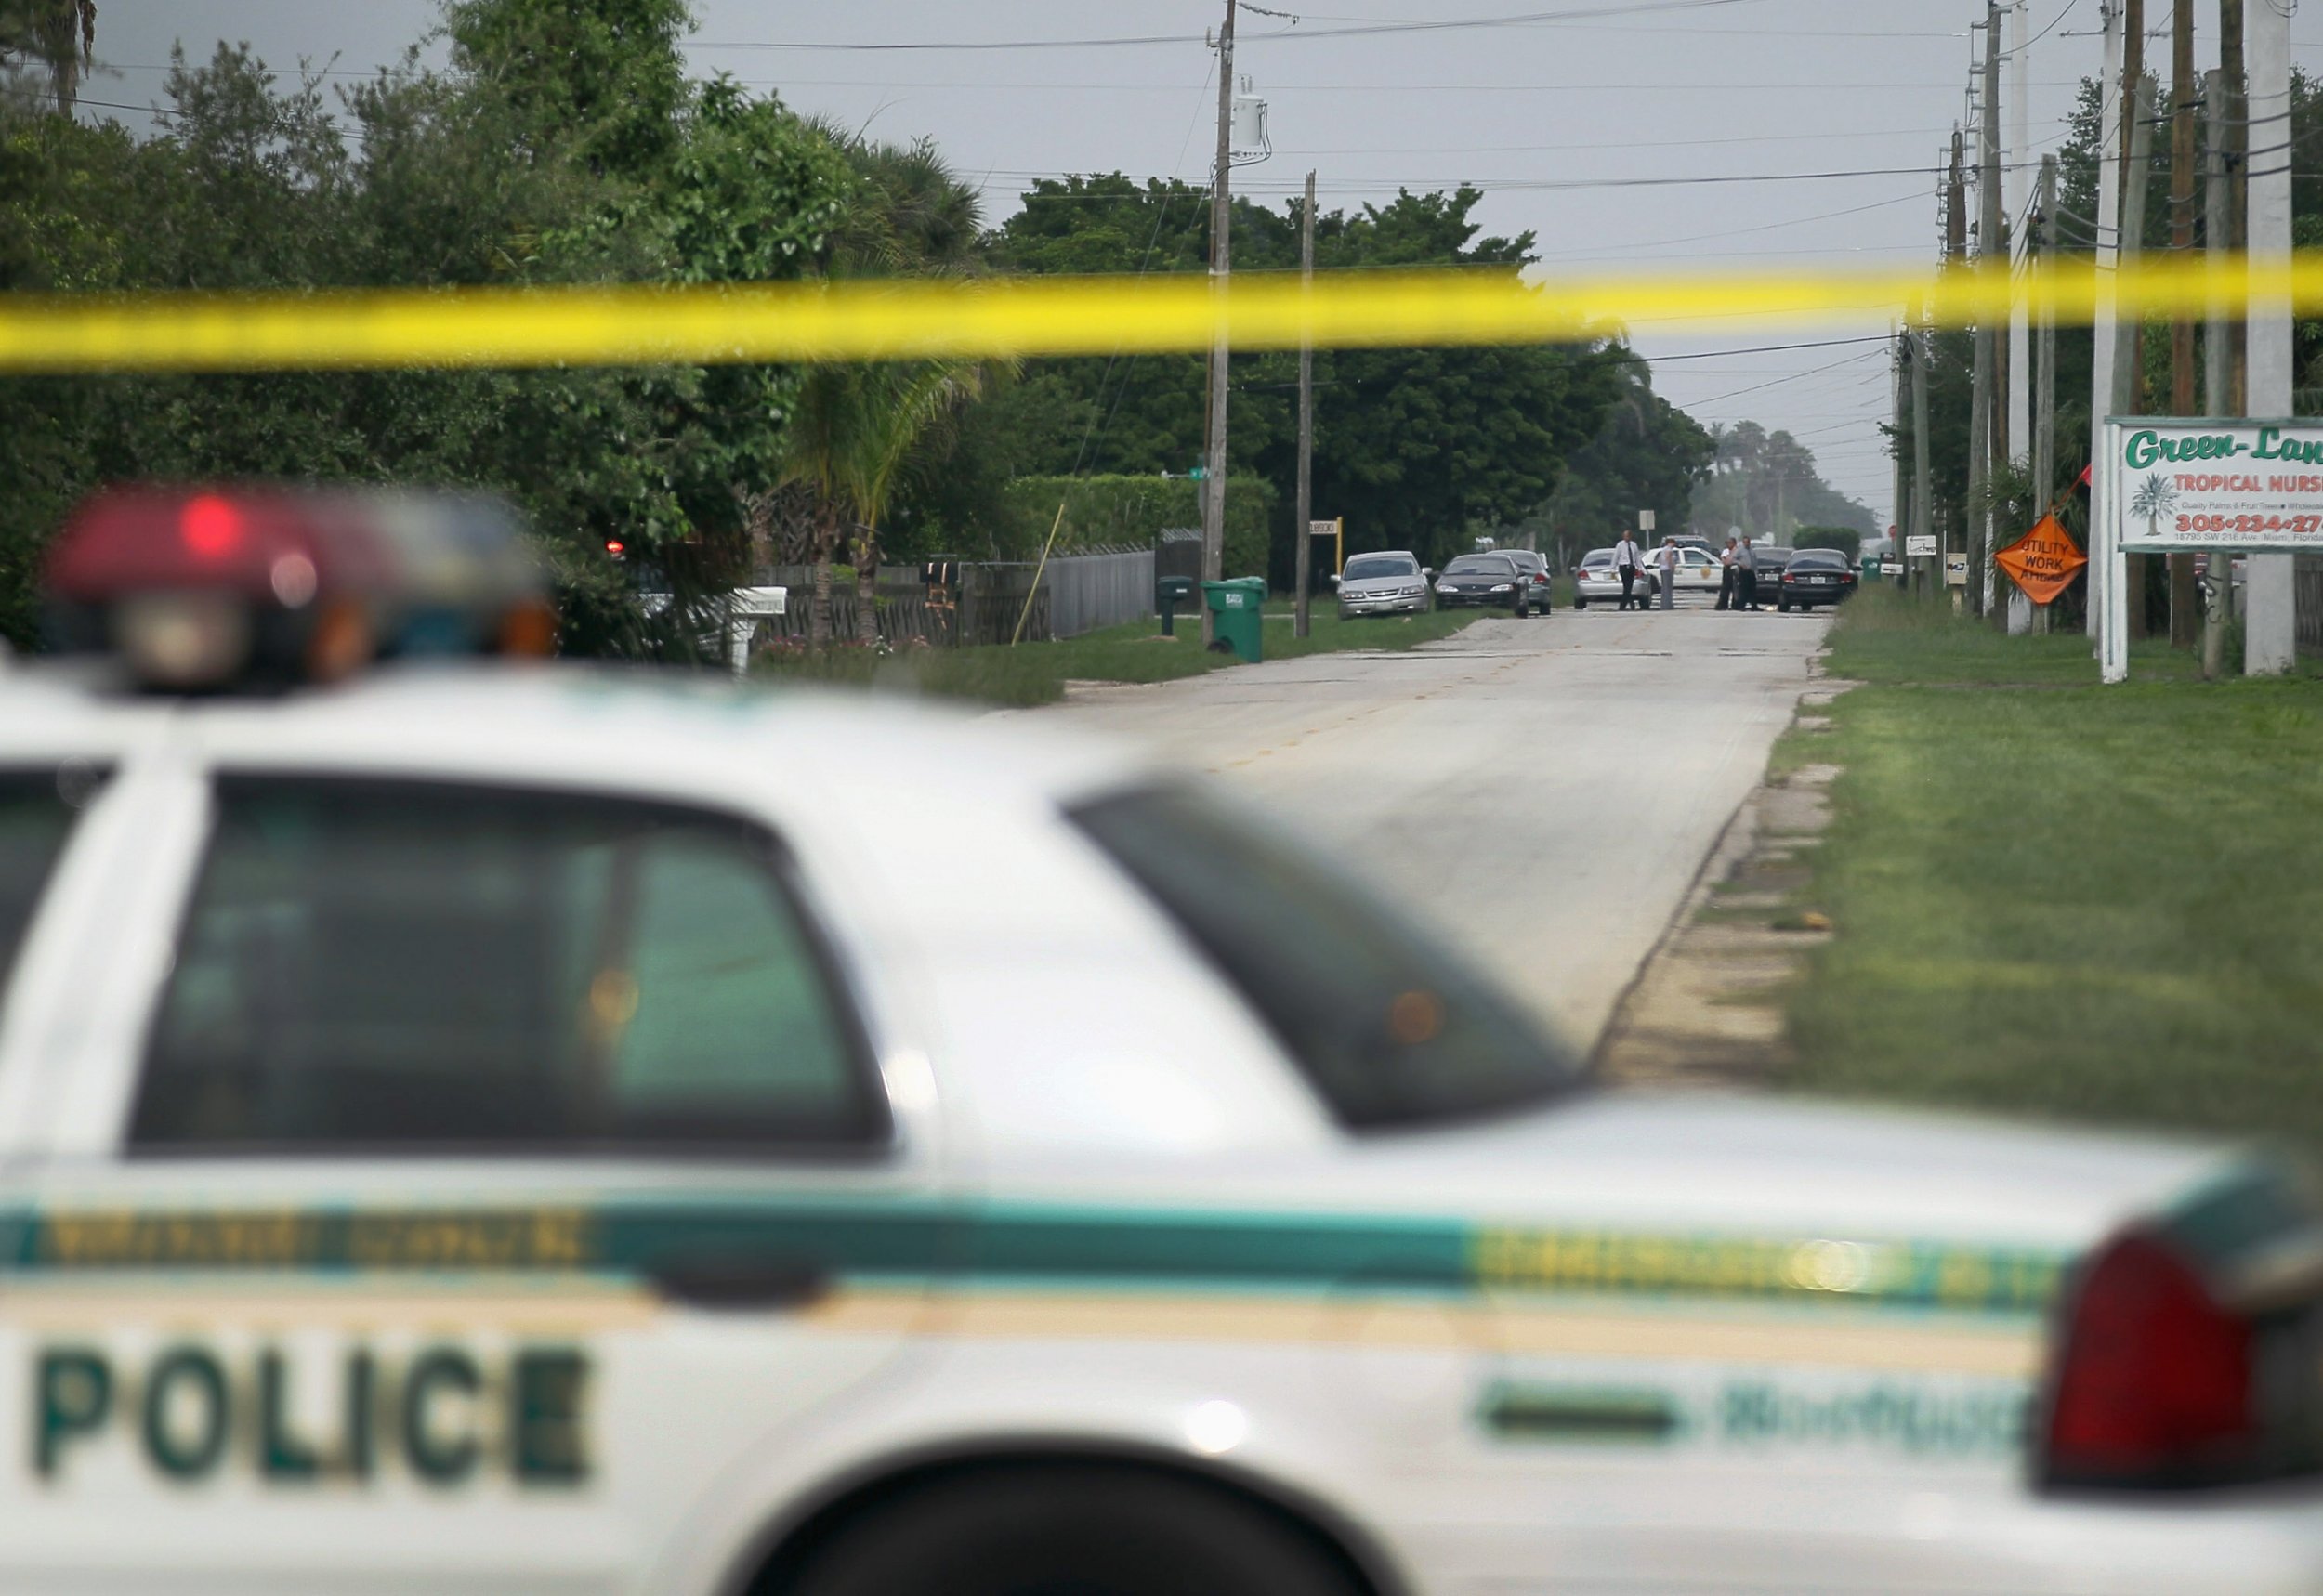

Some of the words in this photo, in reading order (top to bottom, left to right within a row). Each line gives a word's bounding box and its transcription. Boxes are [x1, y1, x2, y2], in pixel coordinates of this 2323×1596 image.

[2174, 474, 2263, 491] TROPICAL
[2269, 475, 2323, 492] NURS
[2204, 532, 2220, 541] SW
[2022, 540, 2068, 555] UTILITY
[2026, 556, 2063, 570] WORK
[33, 1344, 595, 1481] POLICE
